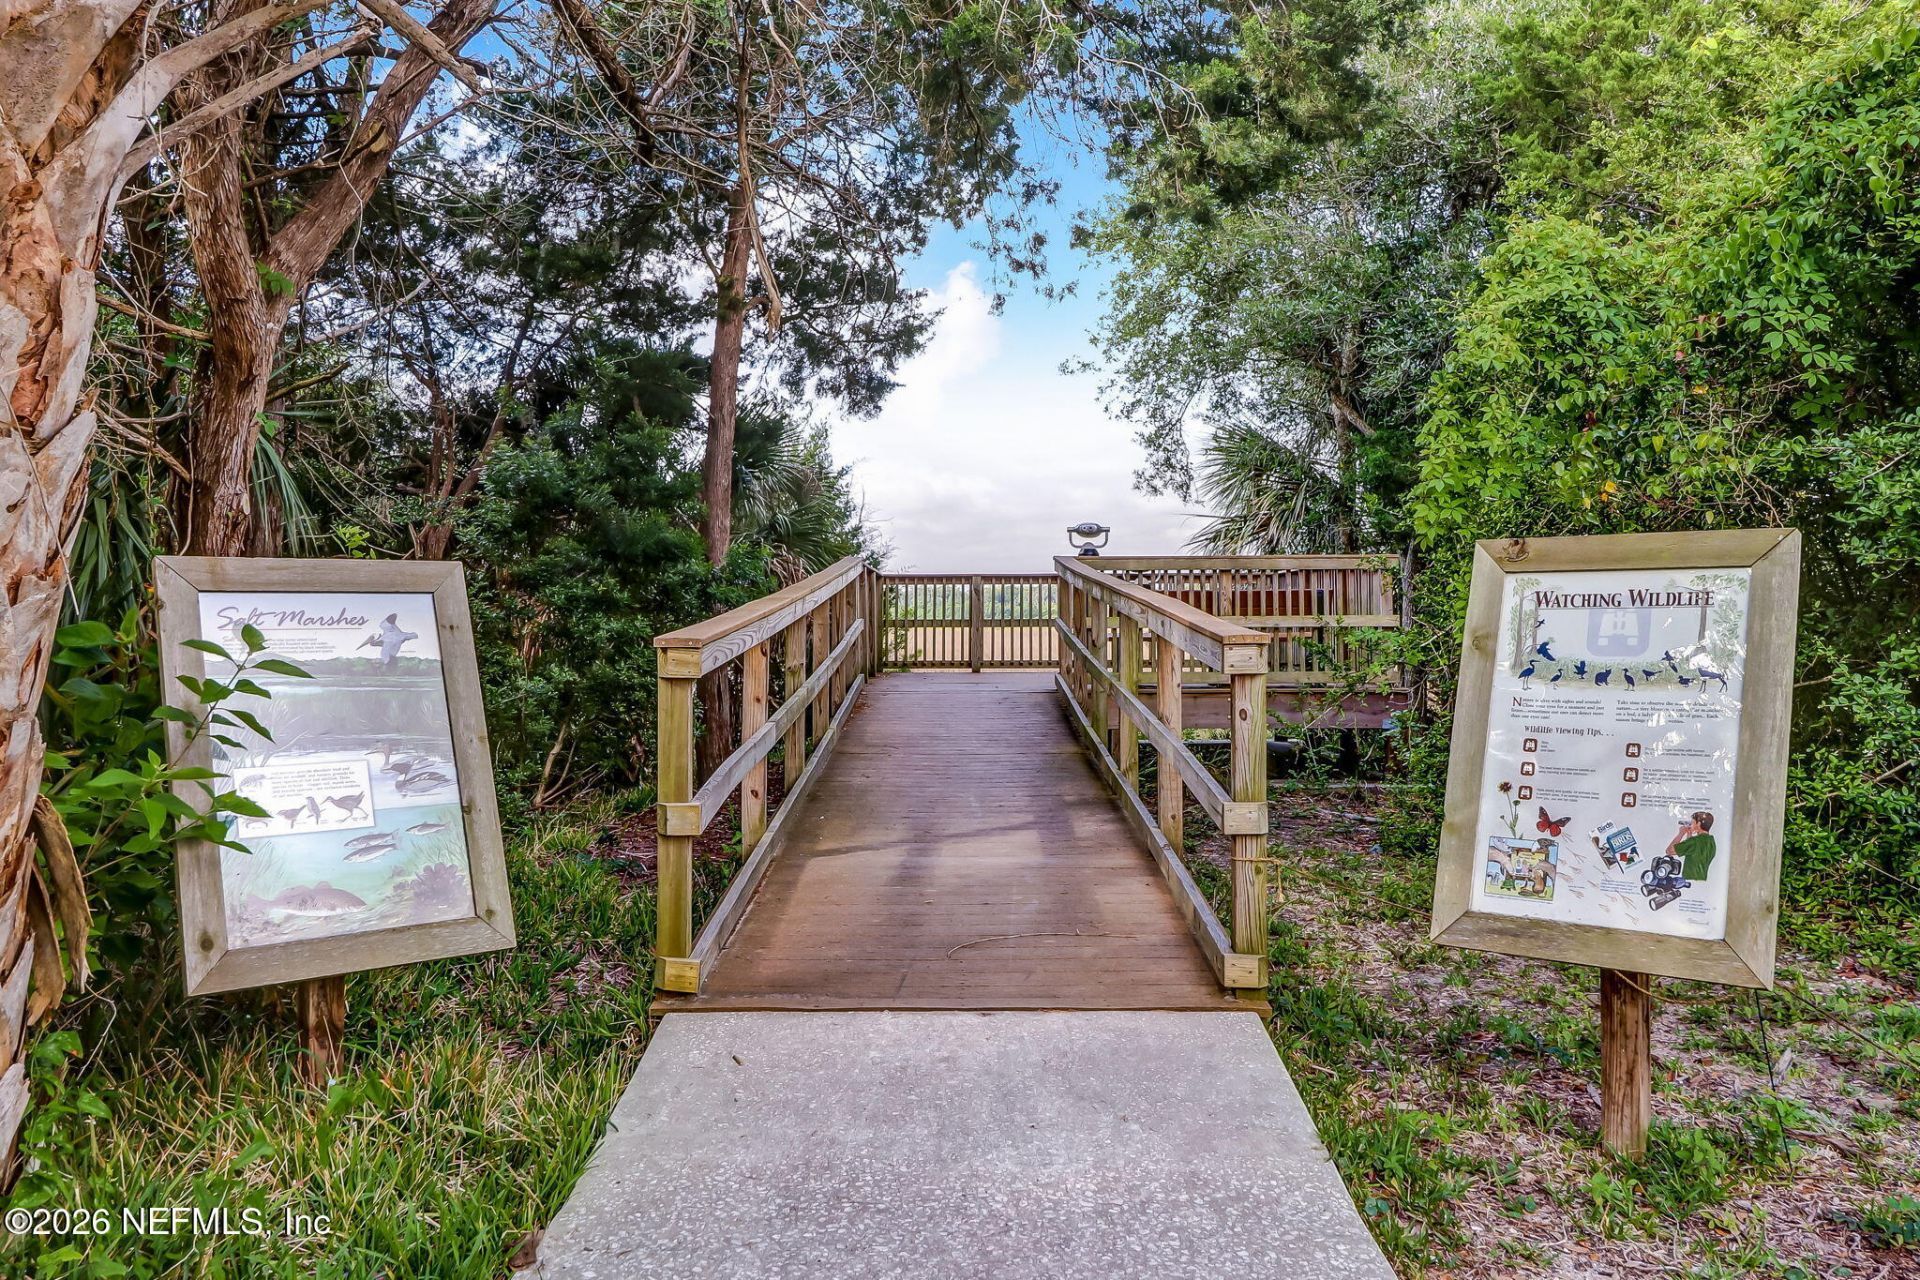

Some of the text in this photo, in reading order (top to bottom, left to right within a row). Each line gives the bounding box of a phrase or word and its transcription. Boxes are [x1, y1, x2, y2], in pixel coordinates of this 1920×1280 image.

[1535, 590, 1622, 608] WATCHING
[217, 606, 369, 629] Salt Marshes
